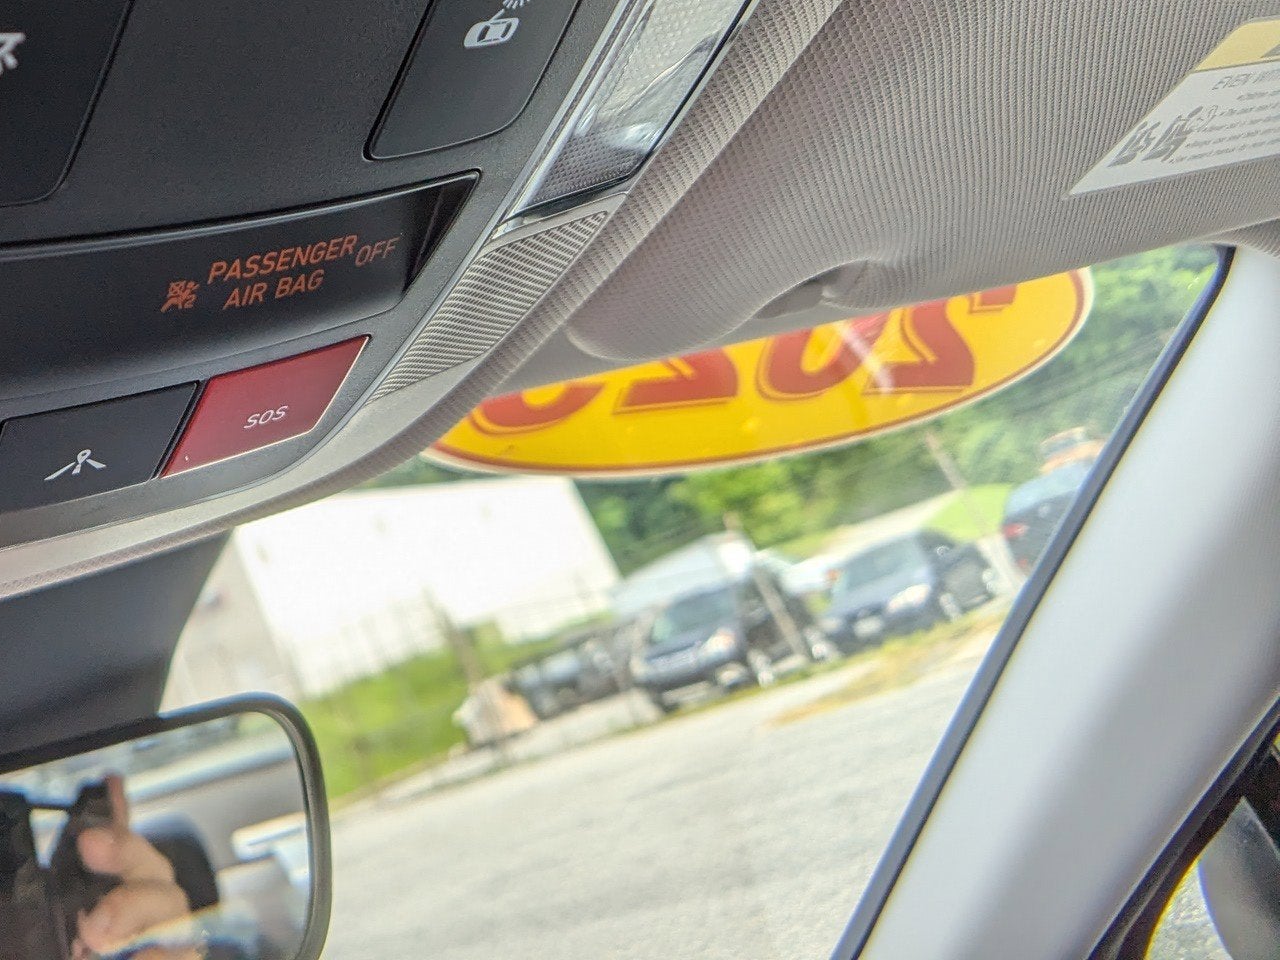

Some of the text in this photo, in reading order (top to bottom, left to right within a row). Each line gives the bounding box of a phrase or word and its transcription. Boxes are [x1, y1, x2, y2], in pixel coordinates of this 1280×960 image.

[207, 234, 359, 285] PASSENGER
[354, 237, 400, 267] OFF
[222, 268, 326, 311] AIR BAG
[243, 405, 289, 429] SOS
